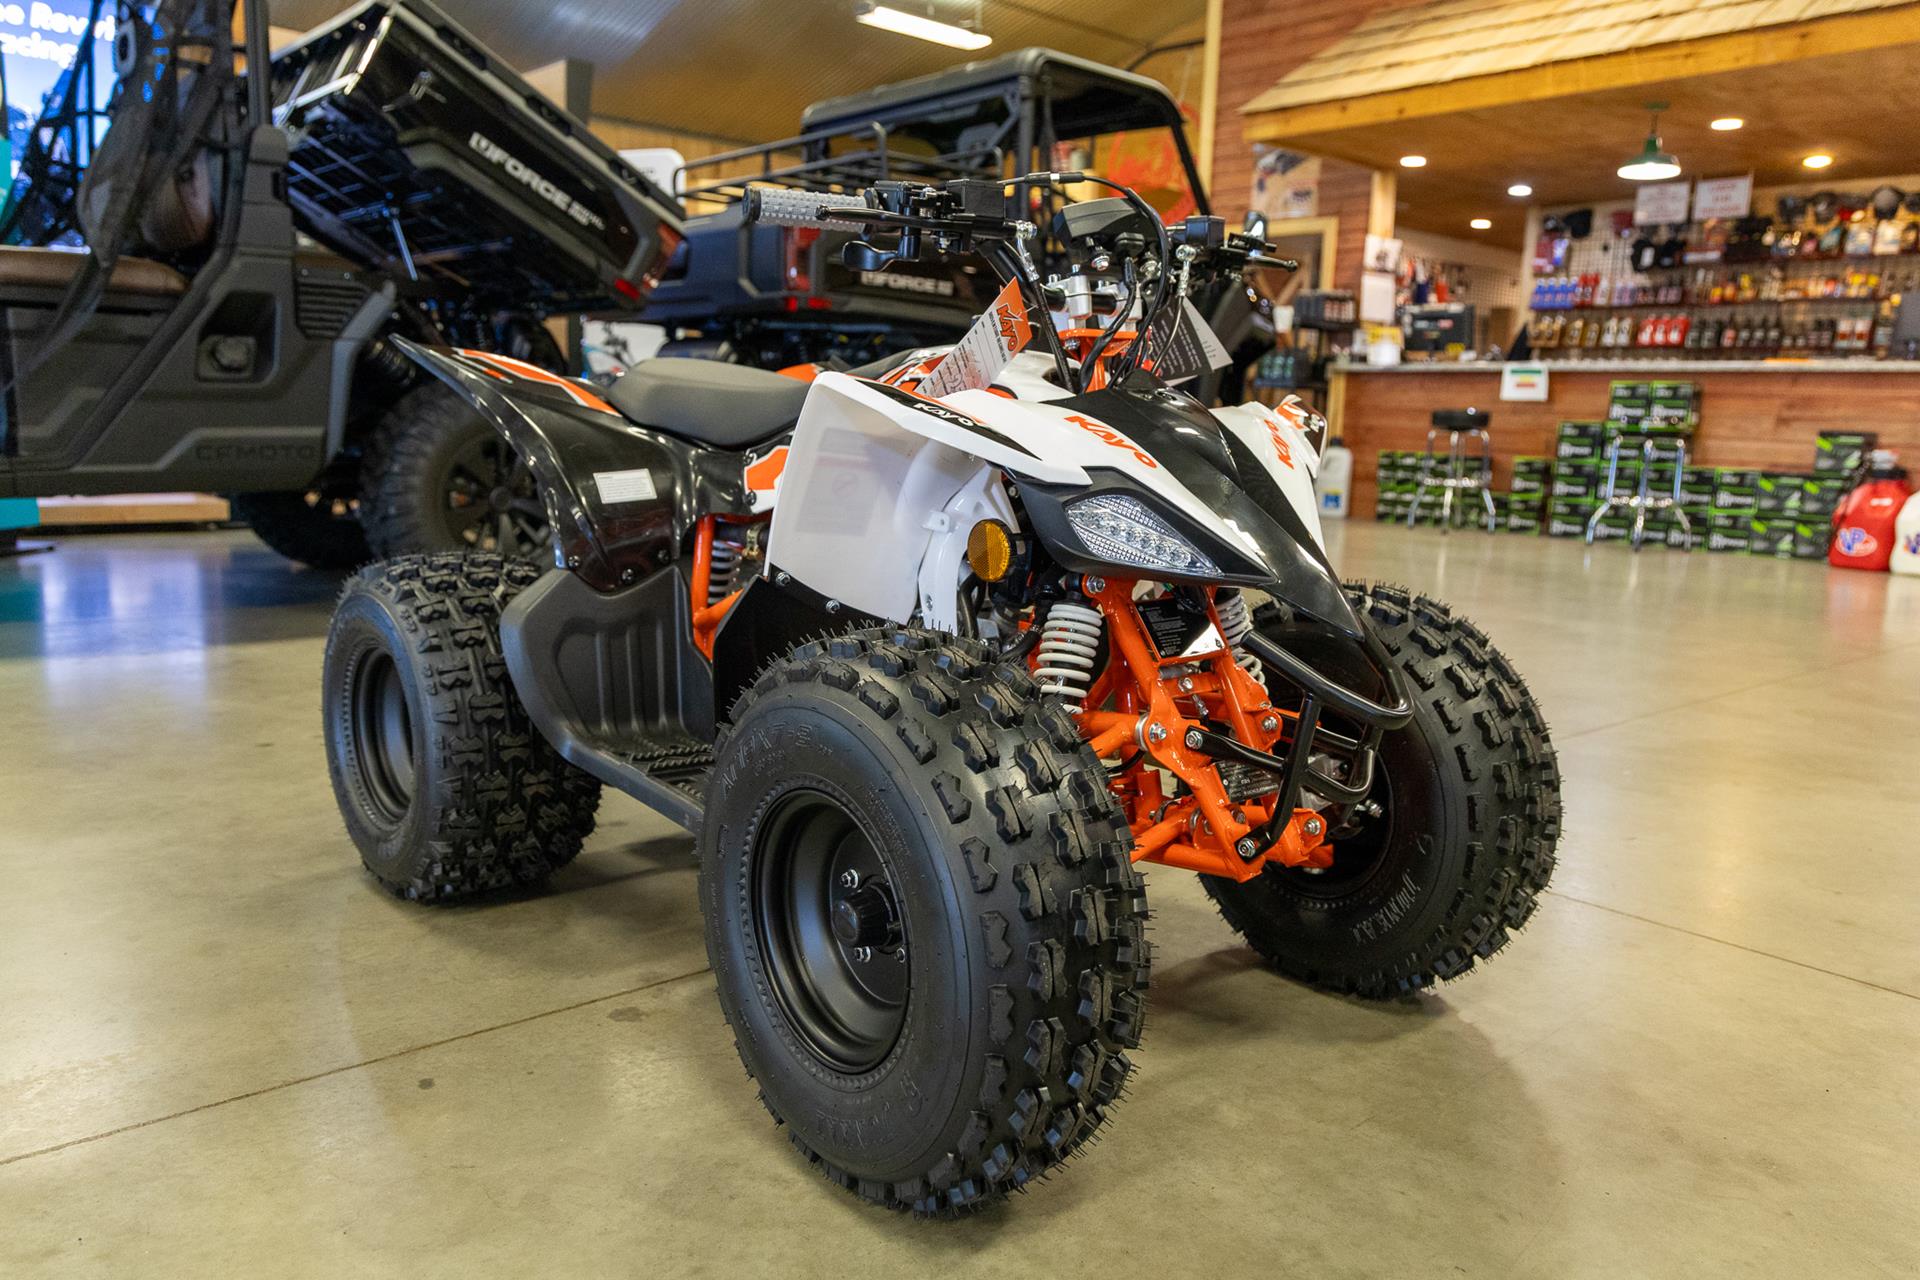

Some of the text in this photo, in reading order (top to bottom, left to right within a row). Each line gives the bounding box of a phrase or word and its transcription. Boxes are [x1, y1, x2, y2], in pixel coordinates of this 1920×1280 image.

[996, 303, 1023, 352] KAYO
[915, 403, 975, 427] KAYO
[1064, 415, 1157, 469] KAYO
[1839, 527, 1865, 555] VP
